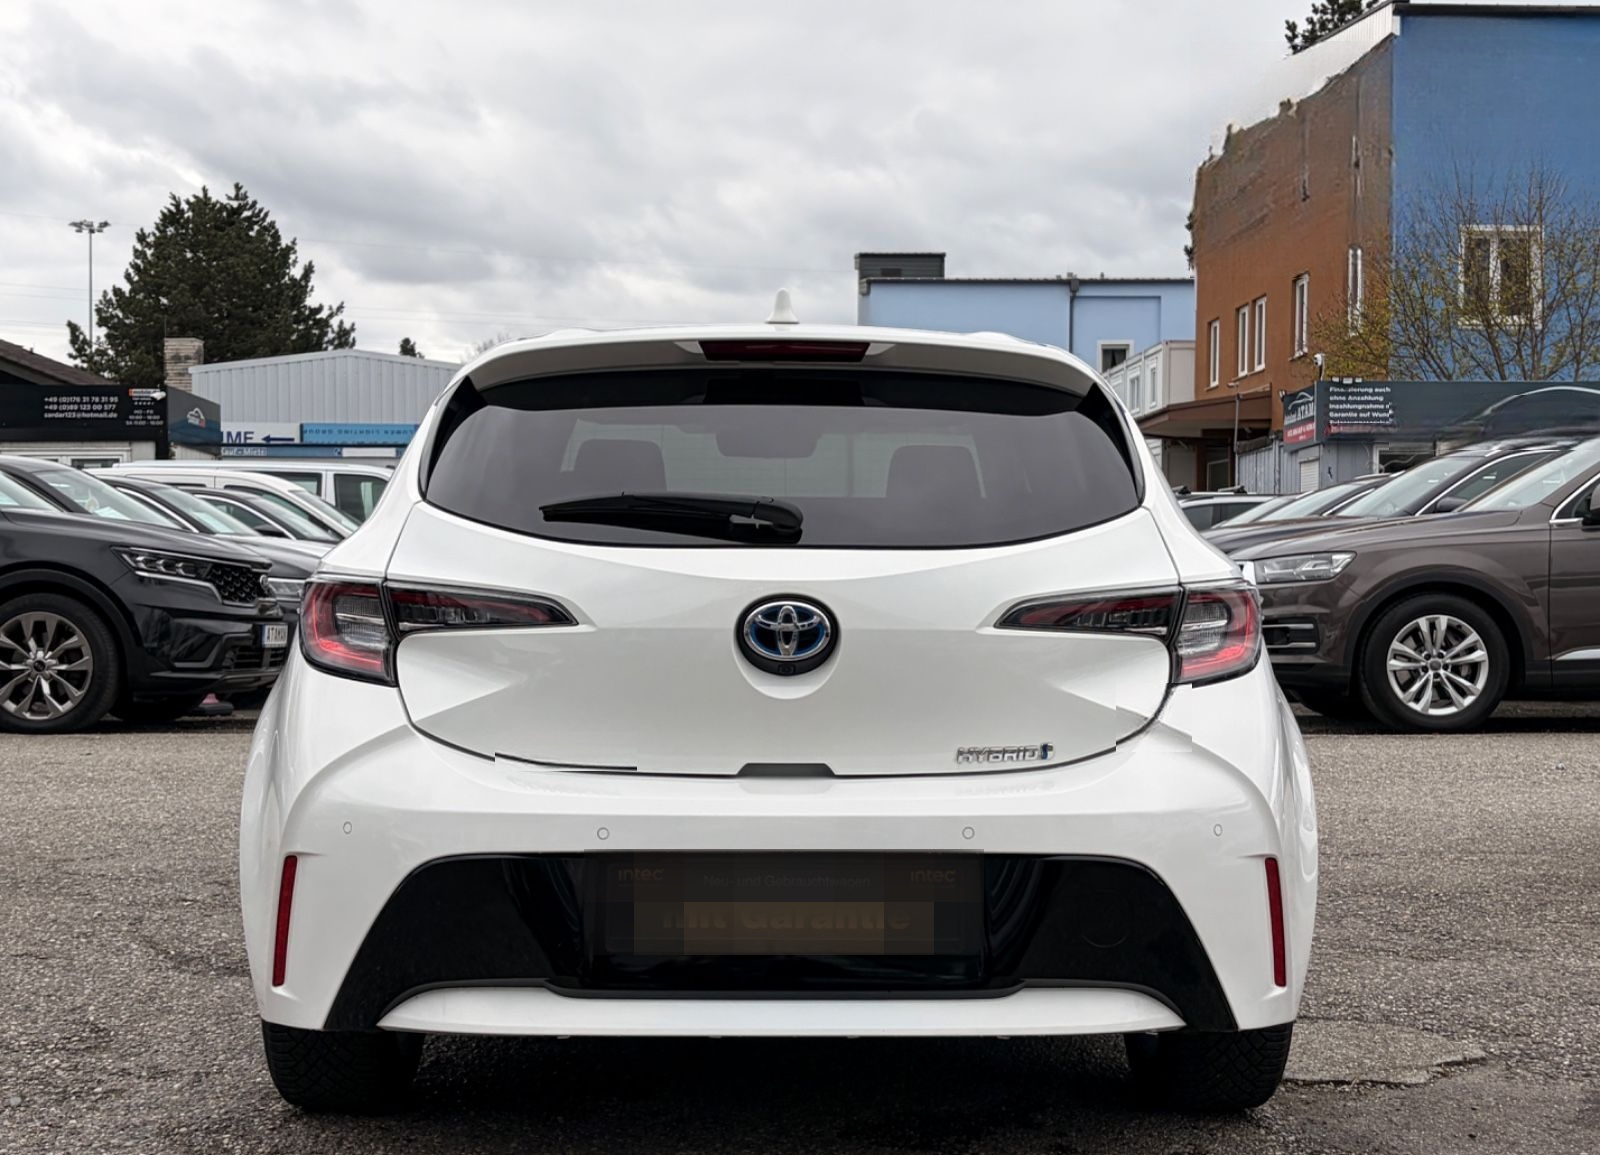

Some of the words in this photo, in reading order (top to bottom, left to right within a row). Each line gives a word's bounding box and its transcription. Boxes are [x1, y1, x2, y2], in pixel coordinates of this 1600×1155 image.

[703, 875, 734, 888] Neu-
[738, 875, 762, 888] und
[765, 875, 871, 892] Gebrauchtwagen
